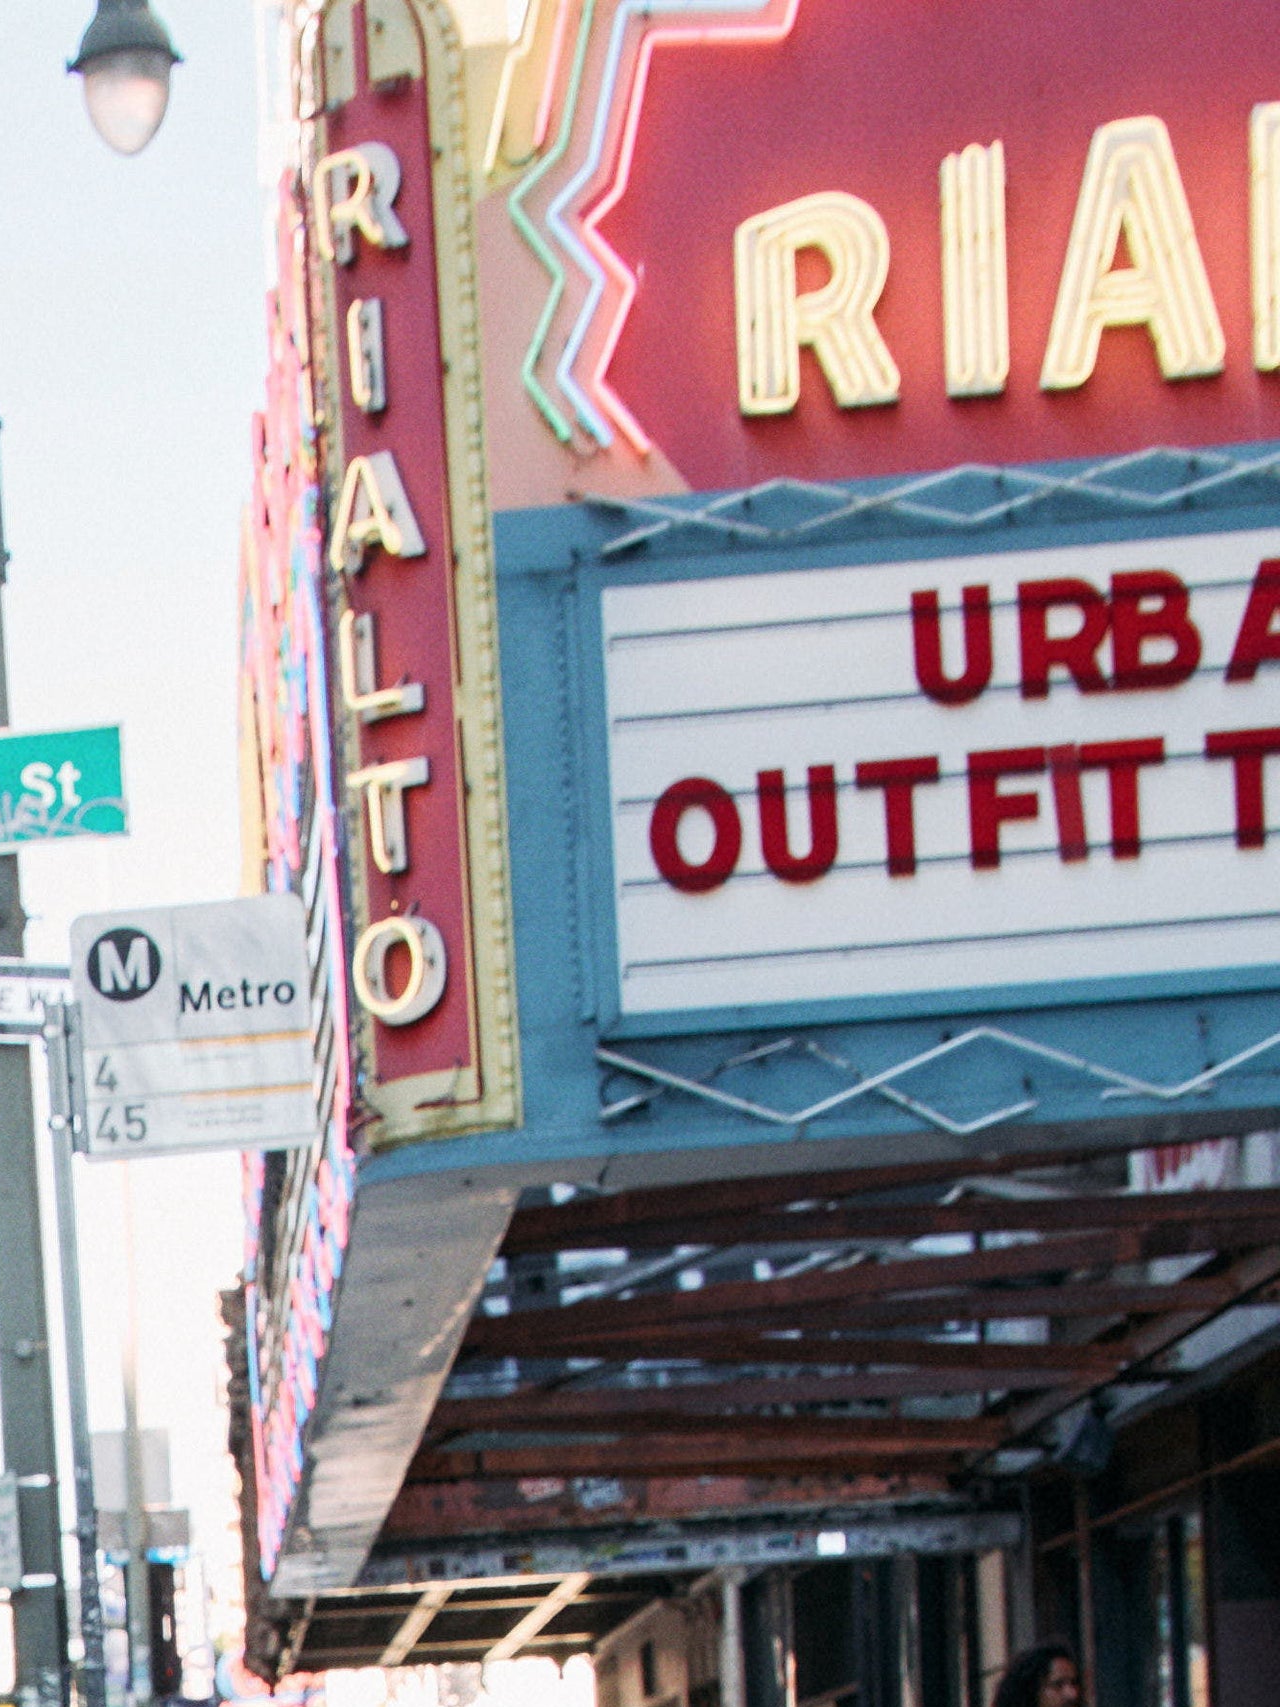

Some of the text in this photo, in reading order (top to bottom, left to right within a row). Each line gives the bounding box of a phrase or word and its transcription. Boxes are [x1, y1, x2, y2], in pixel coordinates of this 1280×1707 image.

[734, 101, 1280, 416] RIA
[313, 141, 446, 1027] RIALTO
[20, 761, 82, 809] St
[649, 736, 1165, 896] OUTFIT
[179, 979, 296, 1014] Metro
[95, 1055, 119, 1093] 4
[96, 1102, 148, 1143] 45
